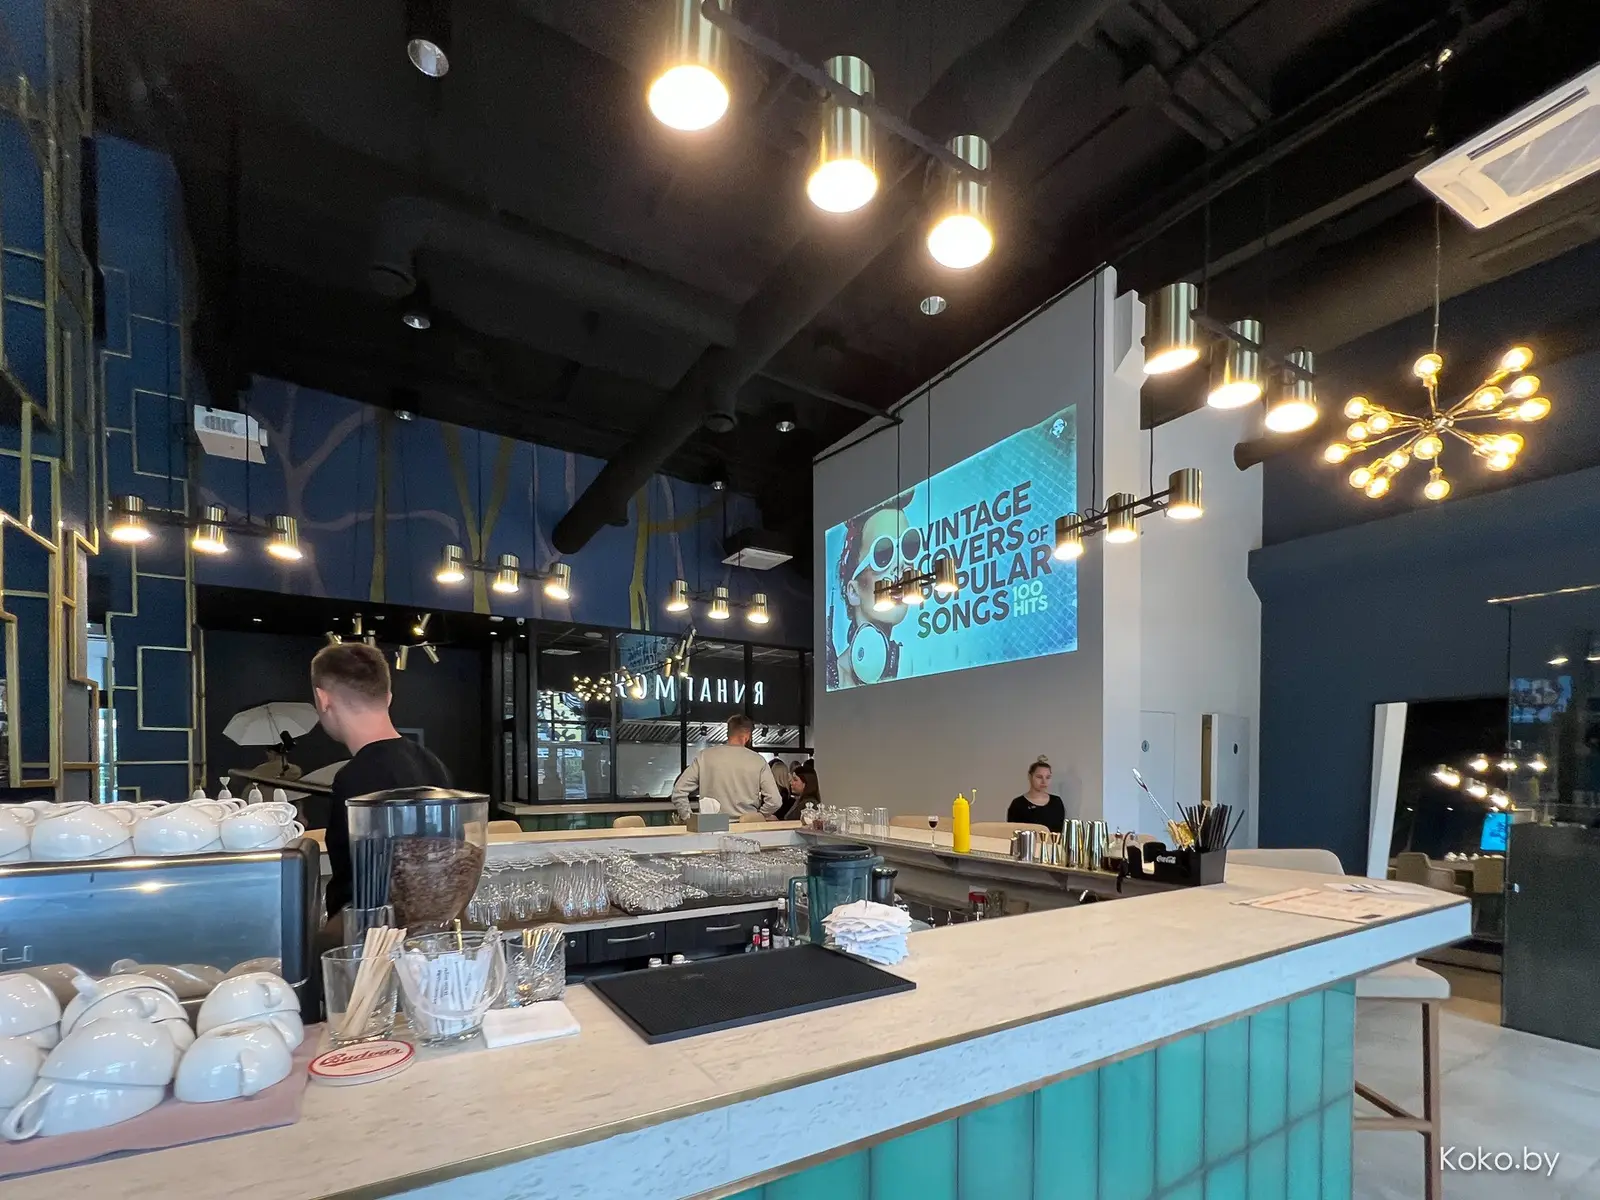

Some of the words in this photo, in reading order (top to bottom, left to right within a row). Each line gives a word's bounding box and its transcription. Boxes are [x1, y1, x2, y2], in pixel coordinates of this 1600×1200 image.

[919, 480, 1032, 551] VINTAGE
[1027, 524, 1049, 544] OF
[1012, 580, 1043, 601] 100
[917, 589, 1010, 639] SONGS
[1013, 594, 1048, 618] HITS
